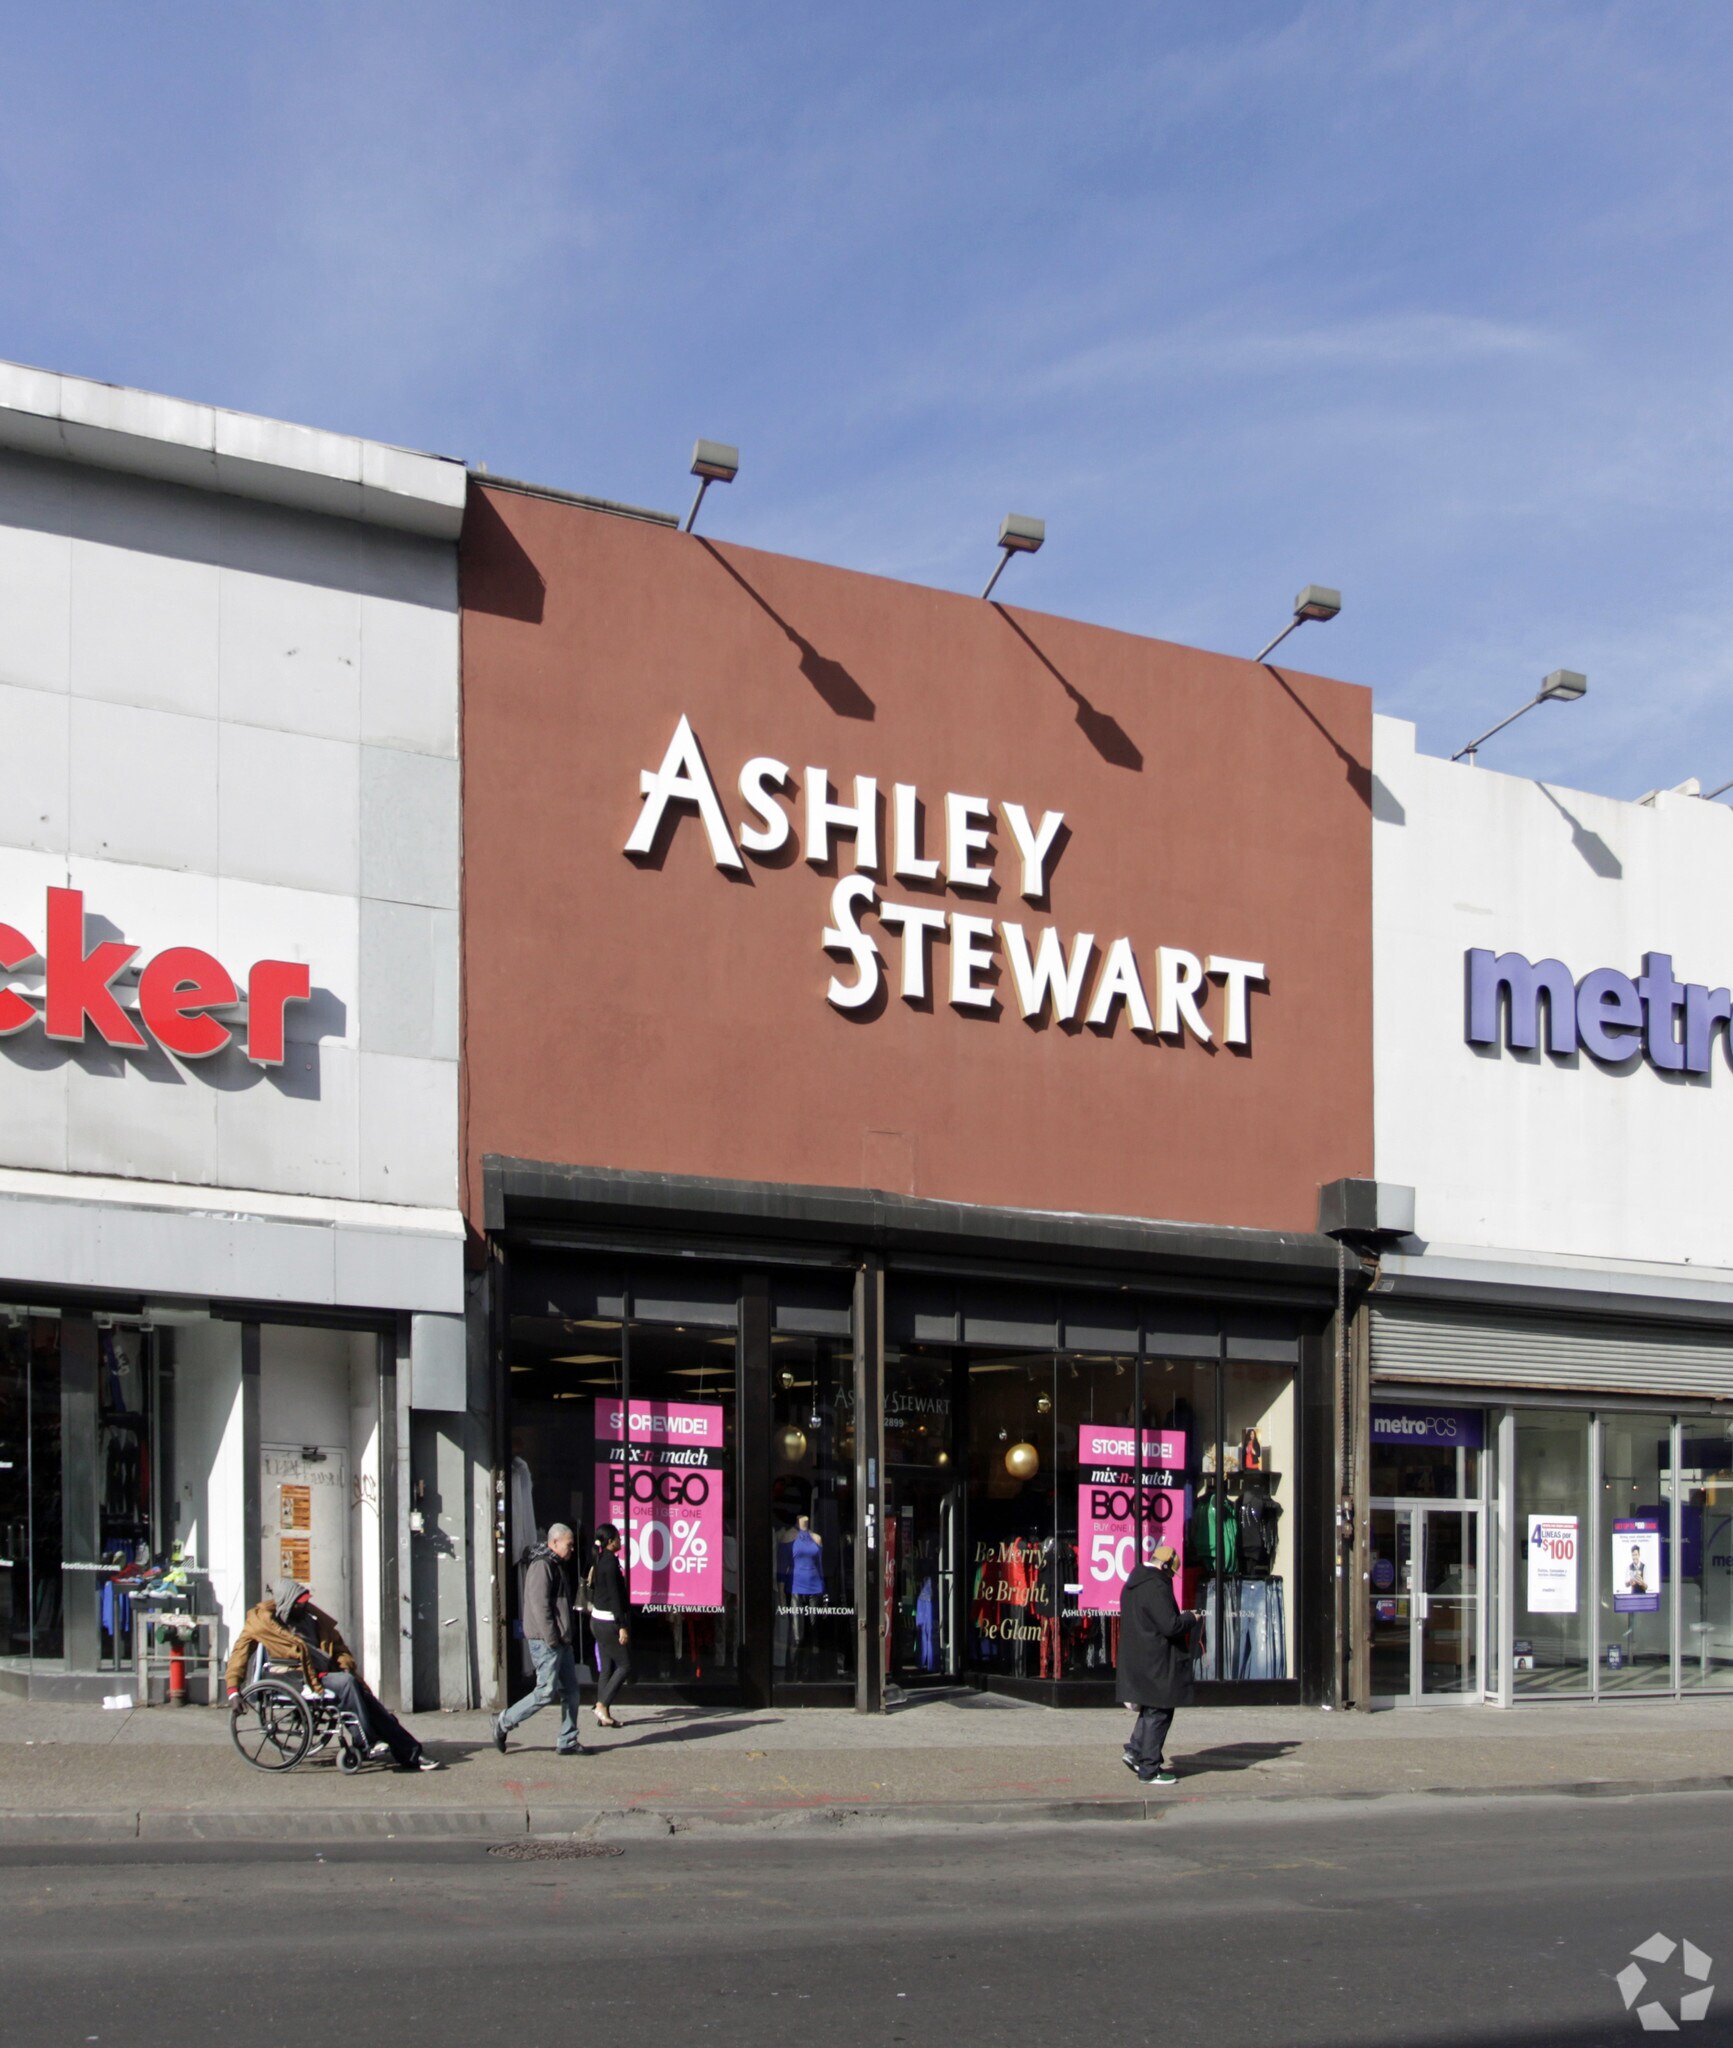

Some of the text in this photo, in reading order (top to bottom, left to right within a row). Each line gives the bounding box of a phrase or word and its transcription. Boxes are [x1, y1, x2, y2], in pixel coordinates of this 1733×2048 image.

[623, 712, 1065, 899] ASHLEY
[821, 874, 1265, 1046] STEWART
[1464, 947, 1733, 1073] metr
[892, 1390, 951, 1415] STEWART
[609, 1412, 708, 1435] SOREWIDE!
[1374, 1416, 1457, 1437] metroPCS
[612, 1504, 625, 1516] BU
[633, 1506, 653, 1516] ONE
[681, 1509, 702, 1519] ONE
[1091, 1490, 1173, 1523] BOGO
[1093, 1522, 1108, 1532] BUY
[1110, 1523, 1128, 1533] ONE
[1530, 1524, 1543, 1548] 4
[1543, 1539, 1574, 1560] $100
[671, 1556, 708, 1574] OFF
[974, 1580, 1049, 1607] Be Bright,
[775, 1605, 854, 1616] ASHLEYSTEWART.COM
[1000, 1618, 1049, 1641] Glam!
